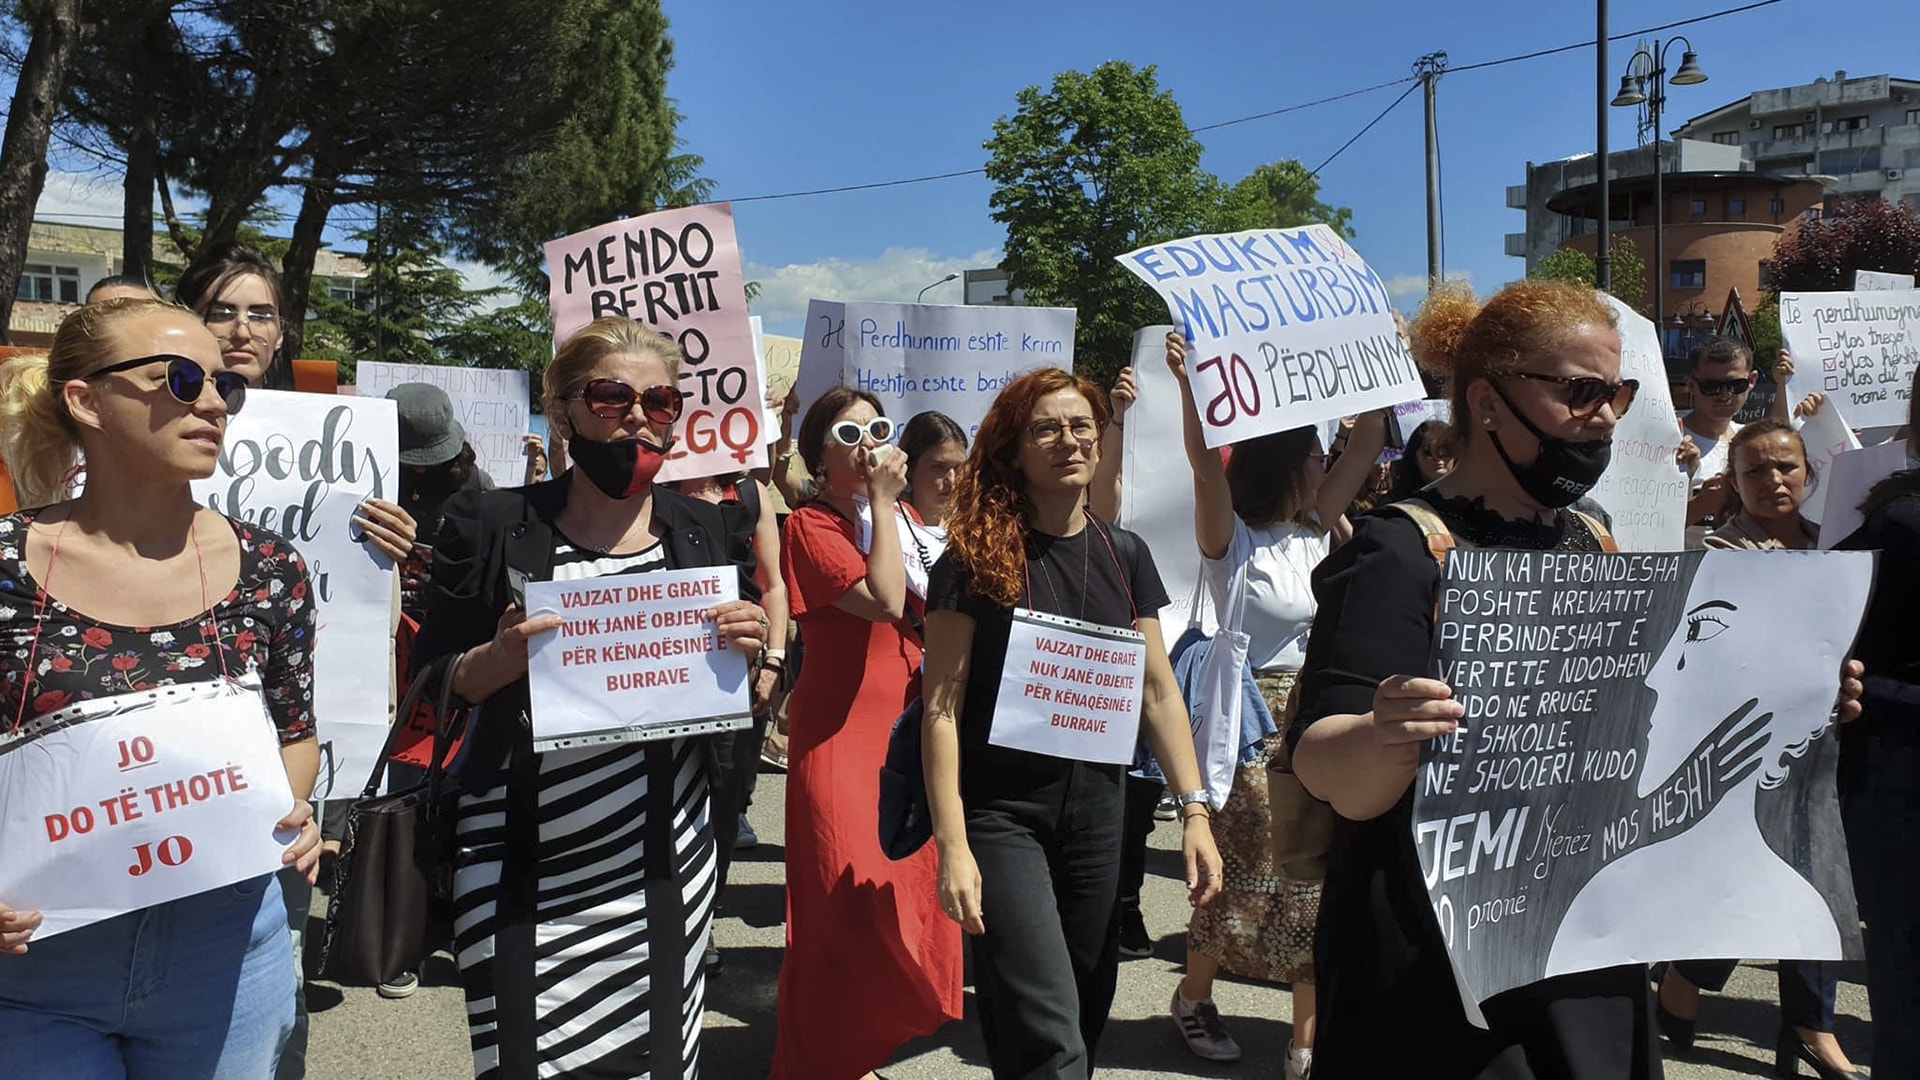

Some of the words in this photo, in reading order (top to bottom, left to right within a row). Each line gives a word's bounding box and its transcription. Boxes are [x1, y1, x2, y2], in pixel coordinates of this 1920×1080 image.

[564, 222, 714, 295] MENDO
[590, 270, 721, 325] BERTIT
[860, 318, 961, 351] Perdhunimi
[857, 368, 917, 400] Heshtja
[1196, 353, 1261, 427] JO
[1447, 550, 1498, 581] NUK
[1505, 552, 1531, 583] KA
[1540, 553, 1680, 584] PERBINDESHA
[560, 587, 623, 609] VAJZAT
[627, 584, 663, 603] DHE
[667, 575, 721, 600] GRATË
[1444, 588, 1543, 616] POSHTE
[1551, 589, 1654, 616] KREVATIT!
[562, 619, 599, 638] NUK
[604, 611, 647, 634] JANË
[1439, 621, 1622, 653] PERBINDESHAT
[1628, 618, 1647, 647] E
[562, 646, 597, 667] PËR
[603, 633, 713, 663] KËNAQËSINË
[717, 634, 727, 650] E
[1035, 636, 1083, 658] VAJZAT
[1084, 647, 1110, 663] DHE
[1111, 651, 1137, 666] GRATË
[606, 667, 690, 692] BURRAVE
[1030, 660, 1060, 679] NUK
[1061, 667, 1095, 685] JANË
[1095, 673, 1134, 689] OBJEKTE
[1437, 659, 1550, 688] VERTETE
[1559, 652, 1651, 684] NDODHEN
[1025, 683, 1051, 701] PËR
[1054, 688, 1126, 712] KËNAQËSINË
[1126, 699, 1132, 712] E
[1506, 695, 1529, 718] NE
[1051, 714, 1107, 733] BURRAVE
[1431, 727, 1468, 754] NE
[118, 736, 154, 768] JO
[1424, 761, 1459, 797] NE
[1581, 747, 1637, 783] KUDO
[44, 806, 95, 843] DO
[99, 787, 143, 826] TË
[1602, 809, 1639, 861] MOS
[1652, 742, 1715, 833] HESHT
[128, 835, 194, 877] JO
[1417, 806, 1530, 891] JEMI
[1526, 803, 1592, 880] Njerëz
